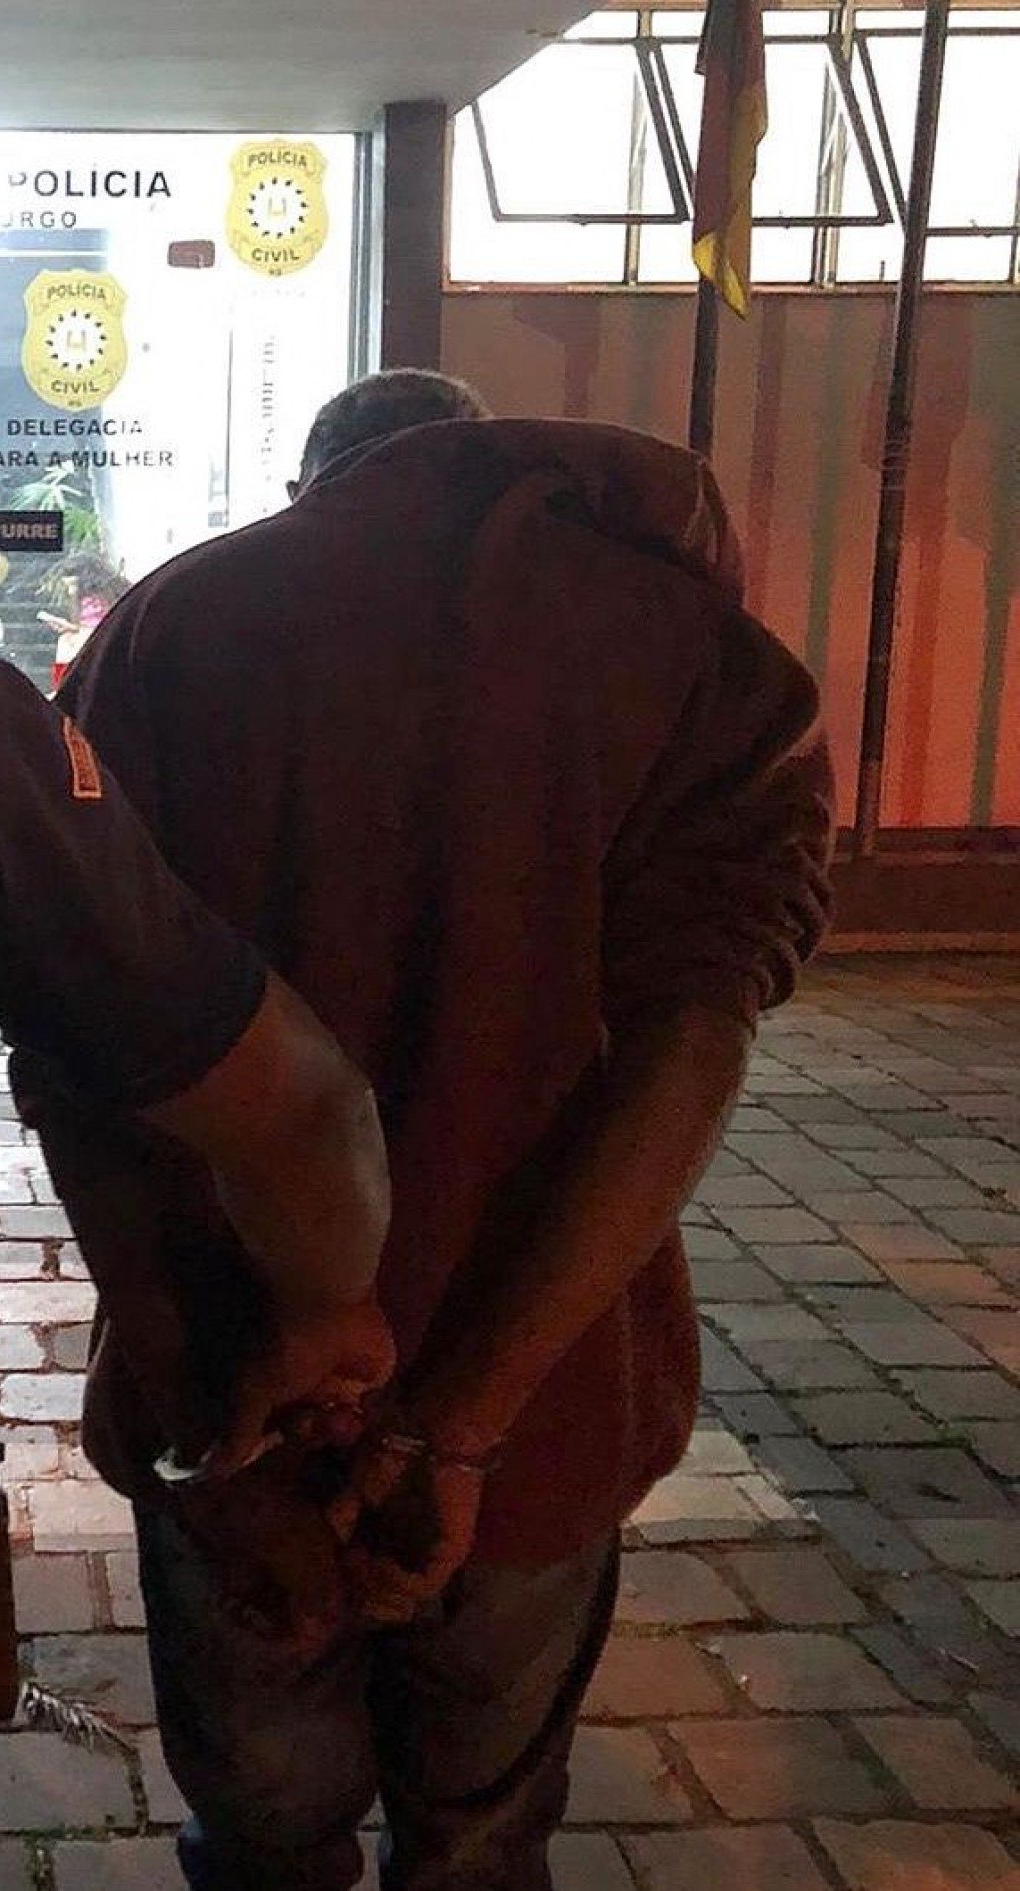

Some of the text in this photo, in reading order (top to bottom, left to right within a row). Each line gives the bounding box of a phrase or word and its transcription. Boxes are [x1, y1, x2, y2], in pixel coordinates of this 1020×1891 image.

[251, 247, 300, 263] CIVIL
[51, 379, 100, 394] CIVIL
[7, 418, 143, 436] DELEGACIA
[48, 450, 63, 467] A
[70, 450, 174, 467] MULHER
